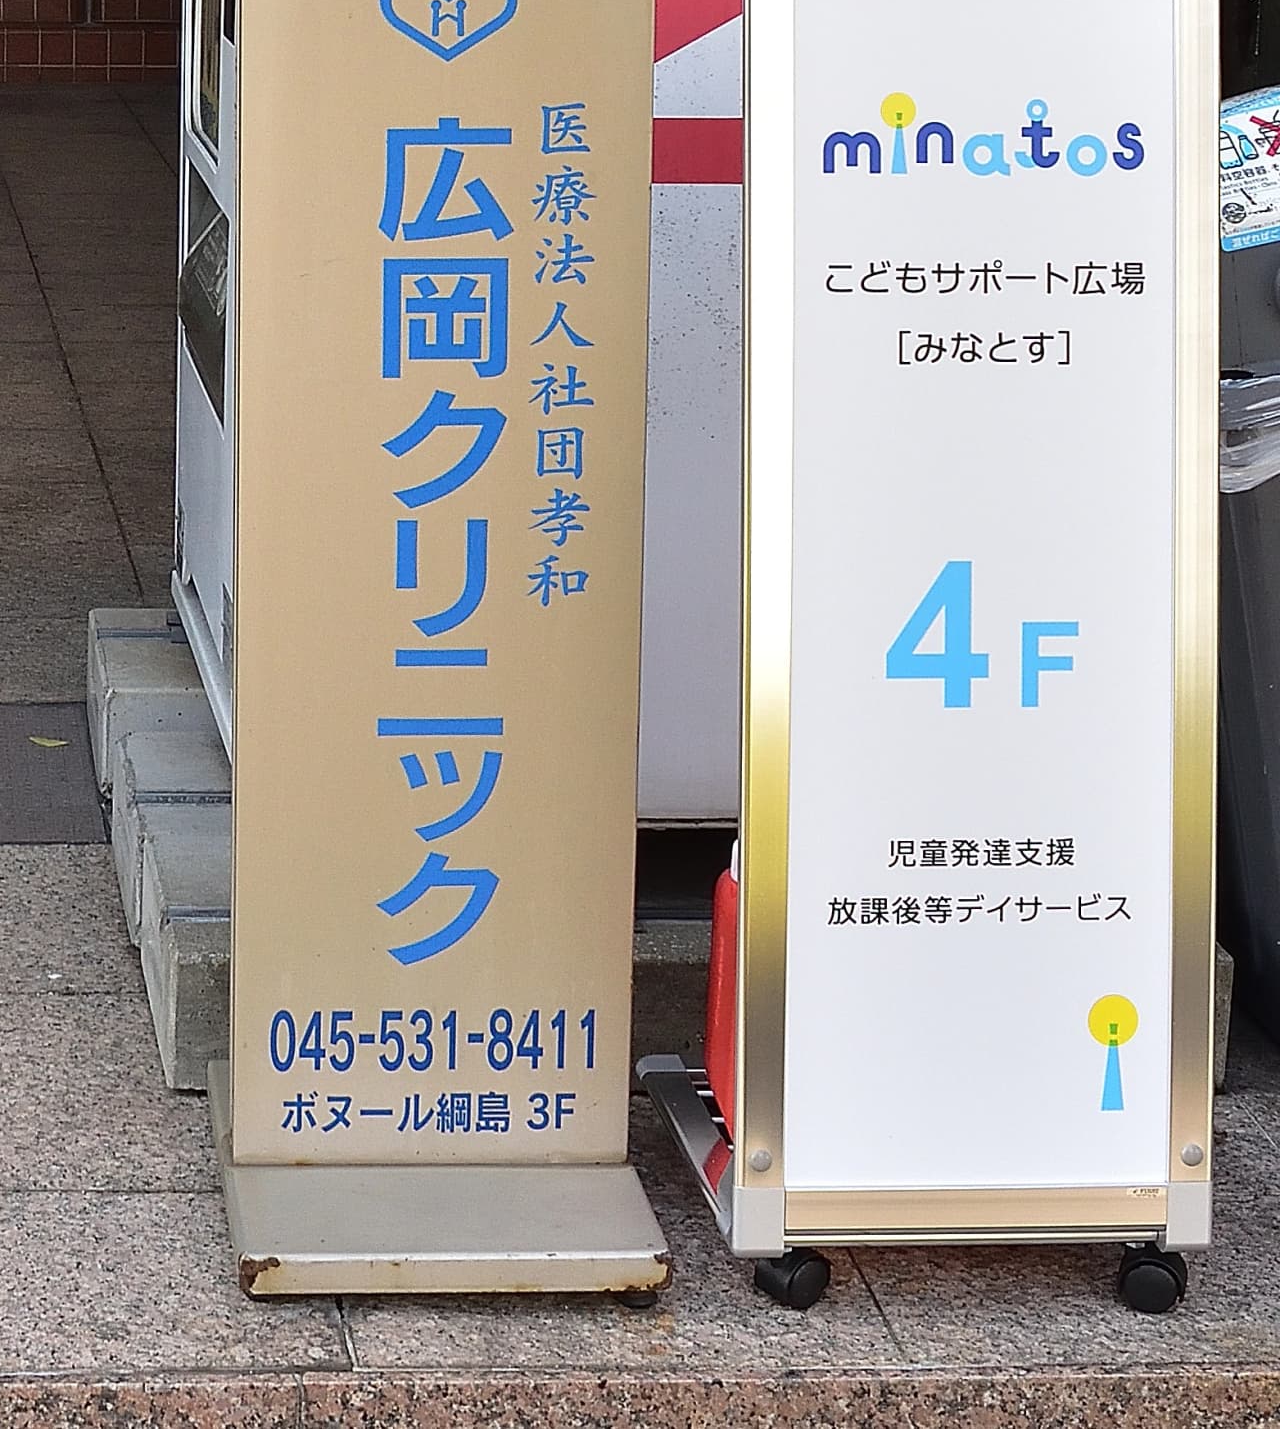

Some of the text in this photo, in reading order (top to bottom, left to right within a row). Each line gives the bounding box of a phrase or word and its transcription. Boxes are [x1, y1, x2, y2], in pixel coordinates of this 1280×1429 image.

[823, 92, 1145, 177] minatos
[825, 259, 1146, 295] こどもサポート広場
[529, 102, 598, 608] 医療法人社団孝和
[376, 117, 514, 966] 広岡クリニック
[887, 838, 1077, 868] 児童発達支援
[827, 893, 1133, 926] 放課後等デイサービス
[269, 1008, 597, 1072] 045-531-8411
[280, 1092, 577, 1133] ボヌール綱島 3F
